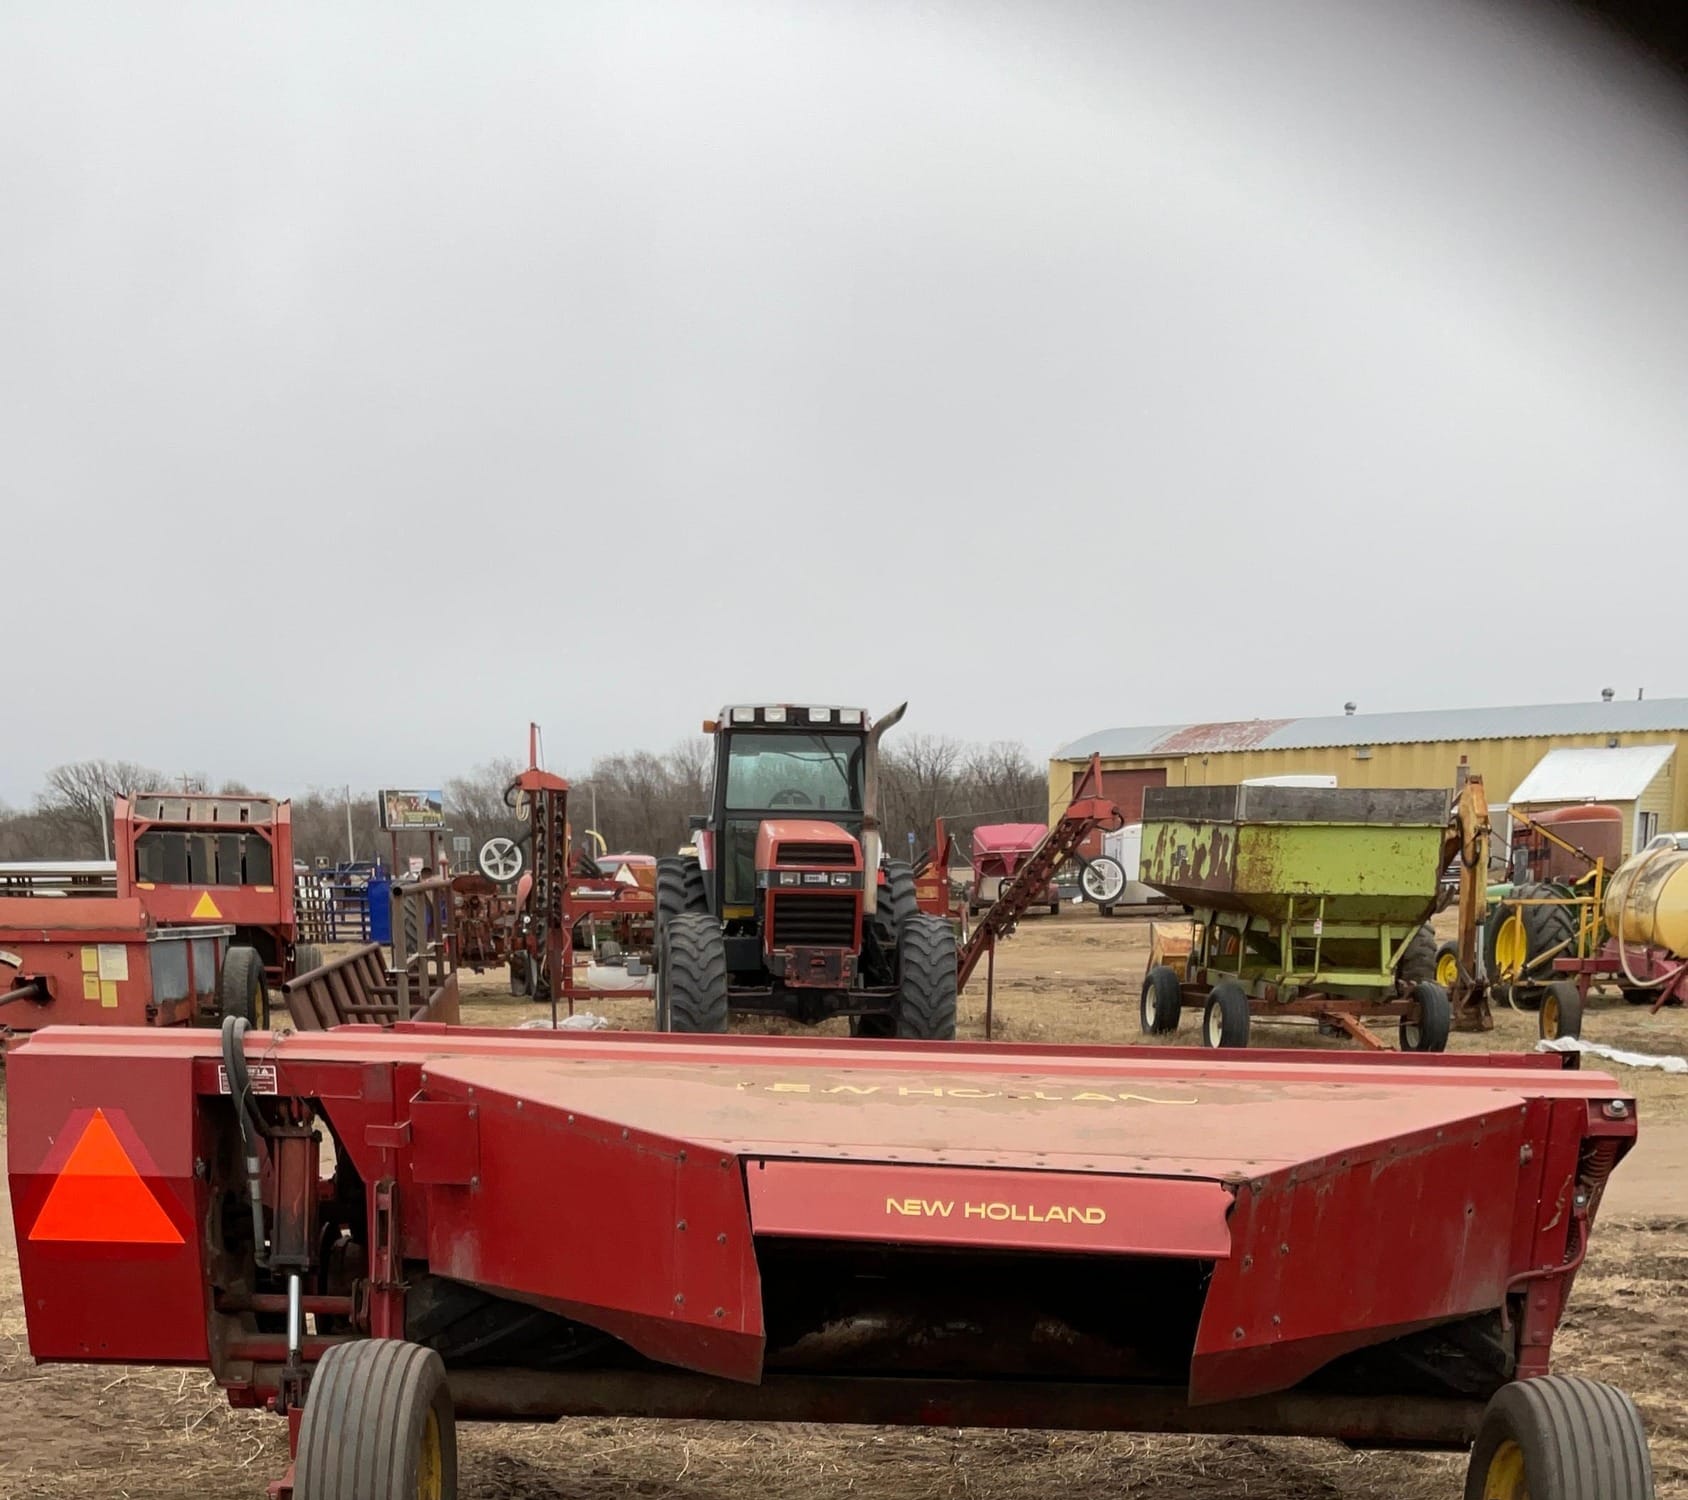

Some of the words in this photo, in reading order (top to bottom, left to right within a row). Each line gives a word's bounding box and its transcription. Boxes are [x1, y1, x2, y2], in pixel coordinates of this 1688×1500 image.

[736, 1081, 881, 1095] EW
[885, 1198, 954, 1217] NEW
[964, 1202, 1107, 1224] HOLLAND
